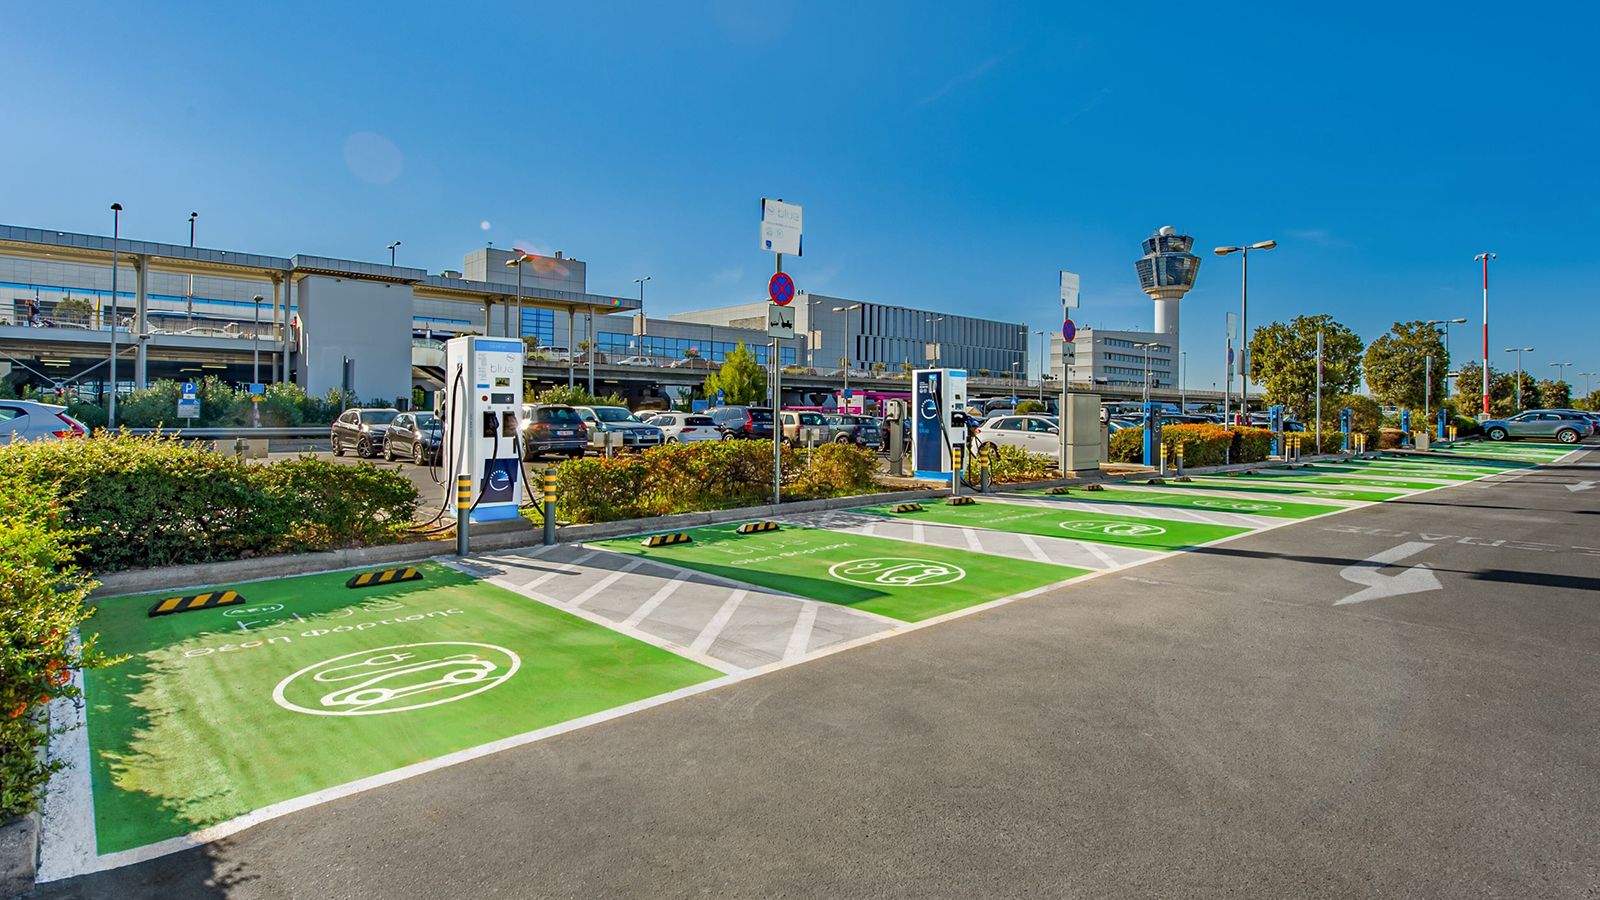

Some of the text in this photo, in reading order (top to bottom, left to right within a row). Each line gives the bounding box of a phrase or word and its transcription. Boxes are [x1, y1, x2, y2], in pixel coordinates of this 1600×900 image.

[490, 363, 514, 374] blue
[185, 383, 193, 393] P
[300, 607, 464, 637] Φόρτισης
